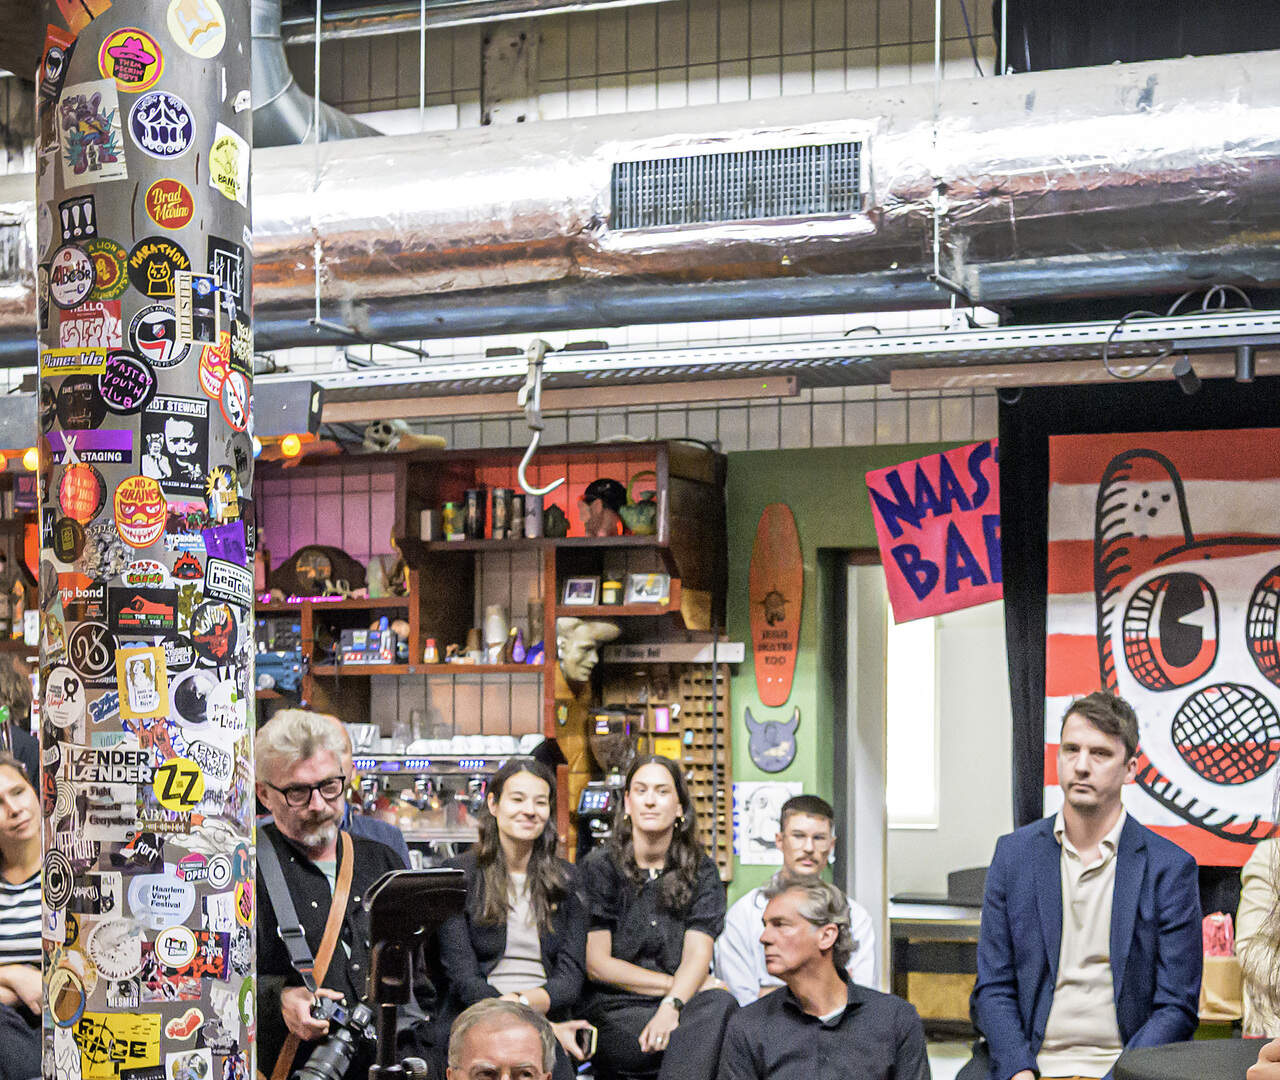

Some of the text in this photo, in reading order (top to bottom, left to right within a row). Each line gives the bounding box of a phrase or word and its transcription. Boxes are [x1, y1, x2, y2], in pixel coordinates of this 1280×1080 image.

[152, 185, 183, 206] Brad
[154, 203, 189, 222] Marino
[96, 242, 118, 252] LION
[130, 243, 190, 270] MARATHON
[107, 355, 153, 386] WASTED
[103, 372, 143, 396] YOUTH
[166, 400, 206, 415] STEWART
[81, 451, 122, 462] STAGING
[134, 479, 146, 488] NO
[120, 488, 159, 501] BRAINS
[75, 586, 103, 599] bond
[186, 867, 209, 881] OPEN
[152, 885, 185, 894] Haarlem
[151, 893, 171, 901] Vinyl
[150, 900, 181, 908] Festival
